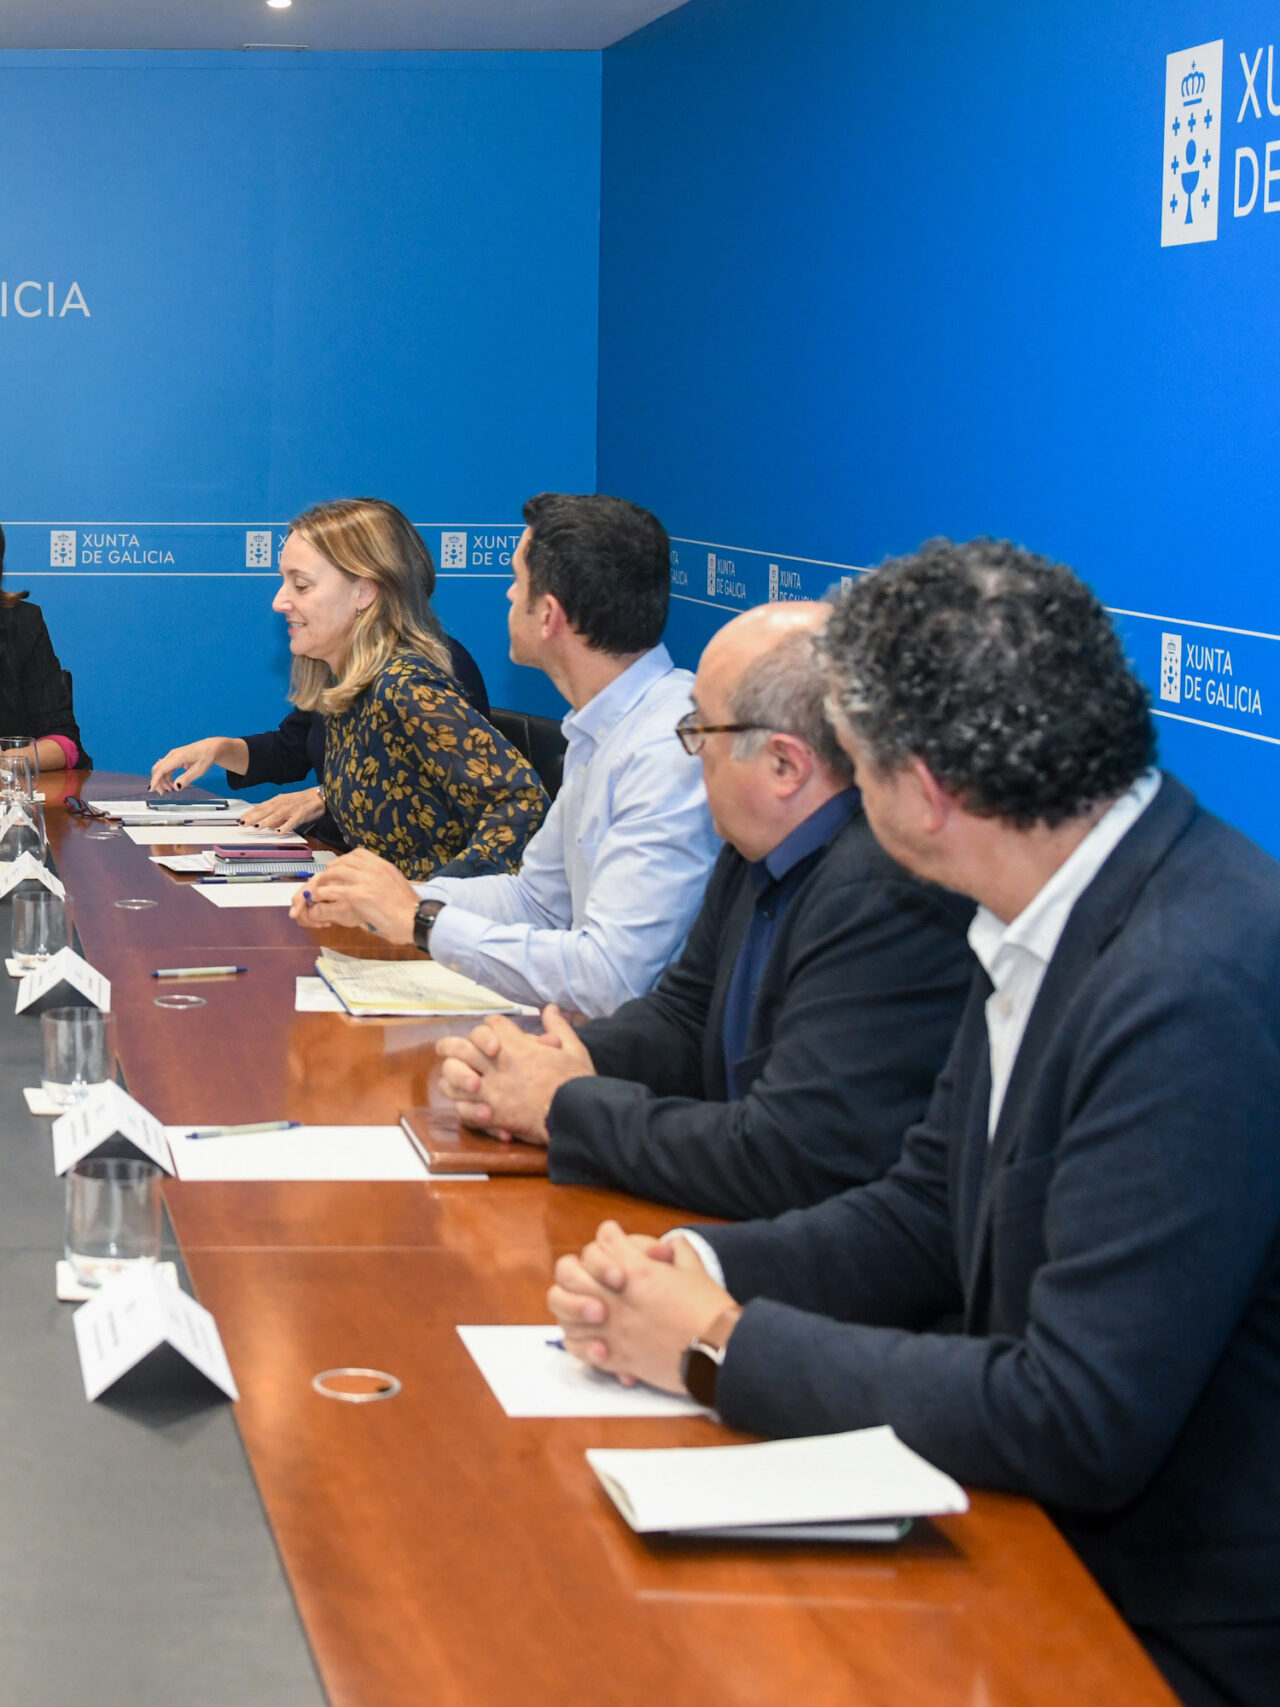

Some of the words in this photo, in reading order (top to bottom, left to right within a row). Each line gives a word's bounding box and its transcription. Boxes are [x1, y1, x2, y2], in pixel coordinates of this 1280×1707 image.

[1233, 138, 1280, 218] DE
[82, 533, 140, 549] XUNTA
[472, 535, 521, 550] XUNT
[81, 551, 103, 565] DE
[108, 550, 176, 565] GALICIA
[472, 552, 494, 566] DE
[716, 559, 736, 577] XUNTA
[780, 569, 802, 591] XUNTA
[1185, 643, 1233, 677] XUNTA
[1184, 674, 1203, 702] DE
[1205, 679, 1263, 716] GALICIA
